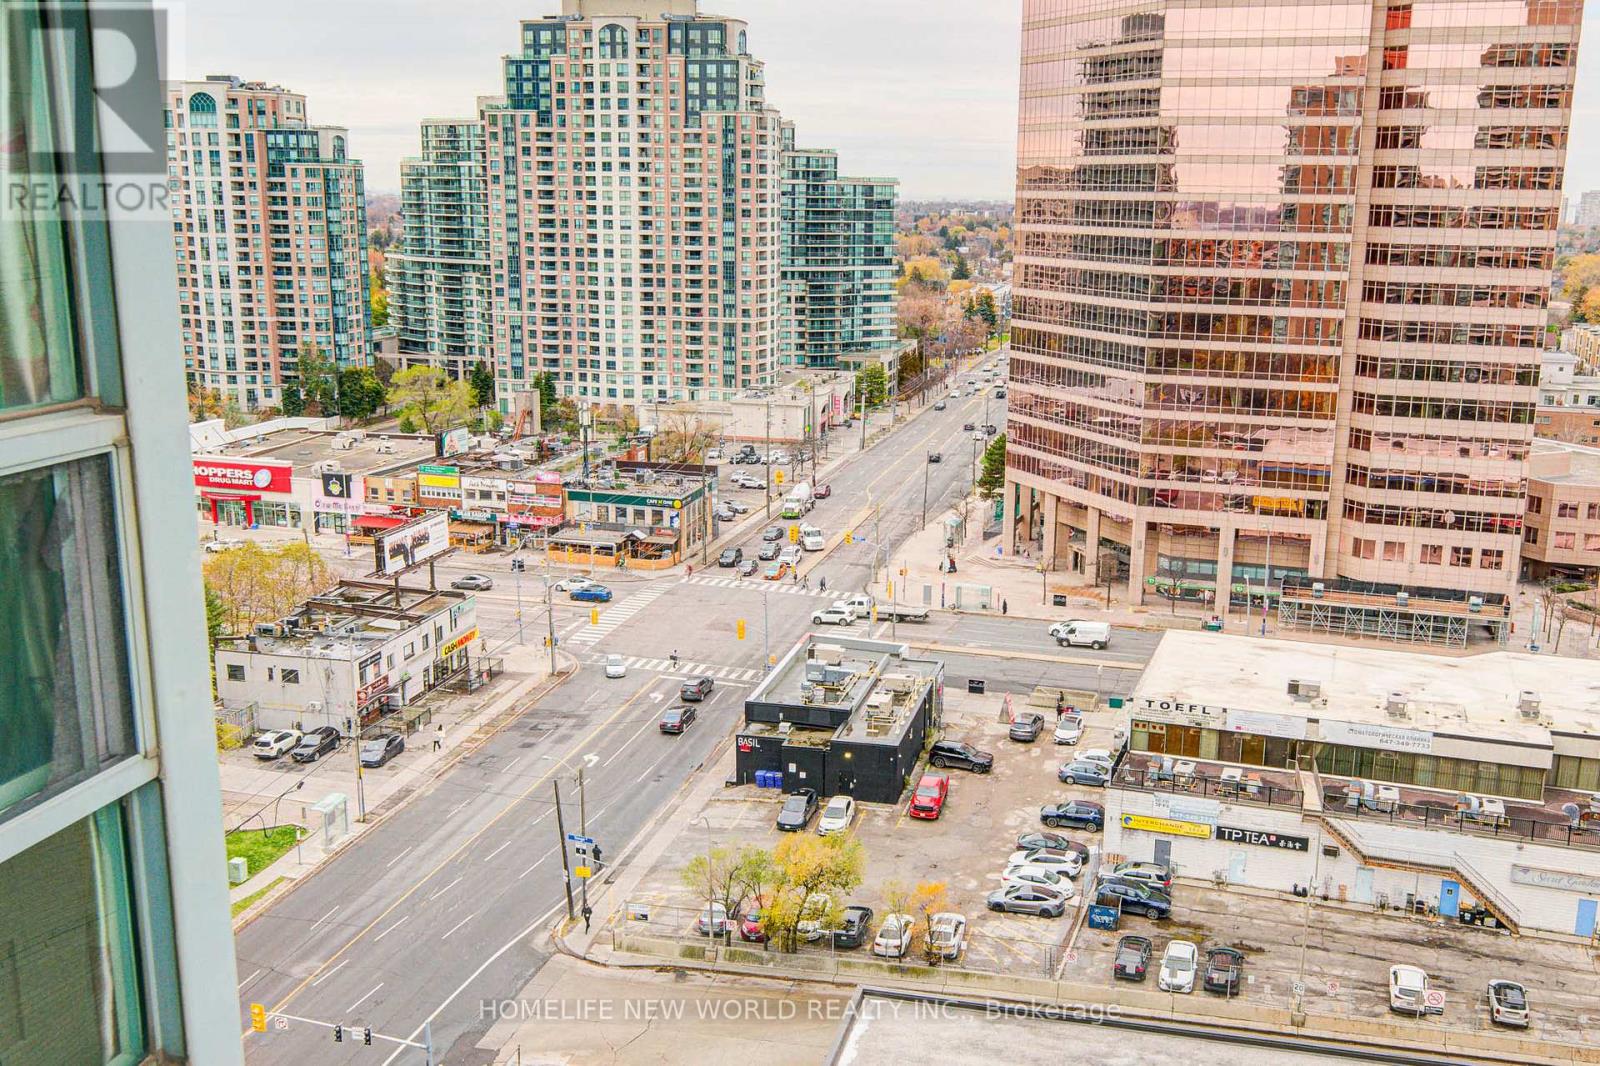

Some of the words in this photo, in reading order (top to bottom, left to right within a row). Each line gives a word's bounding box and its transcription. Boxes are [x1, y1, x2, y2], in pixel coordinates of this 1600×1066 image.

[1145, 699, 1211, 715] TOEFL
[738, 737, 760, 748] BASIL
[1221, 828, 1243, 841] TP
[1243, 831, 1270, 845] TEA
